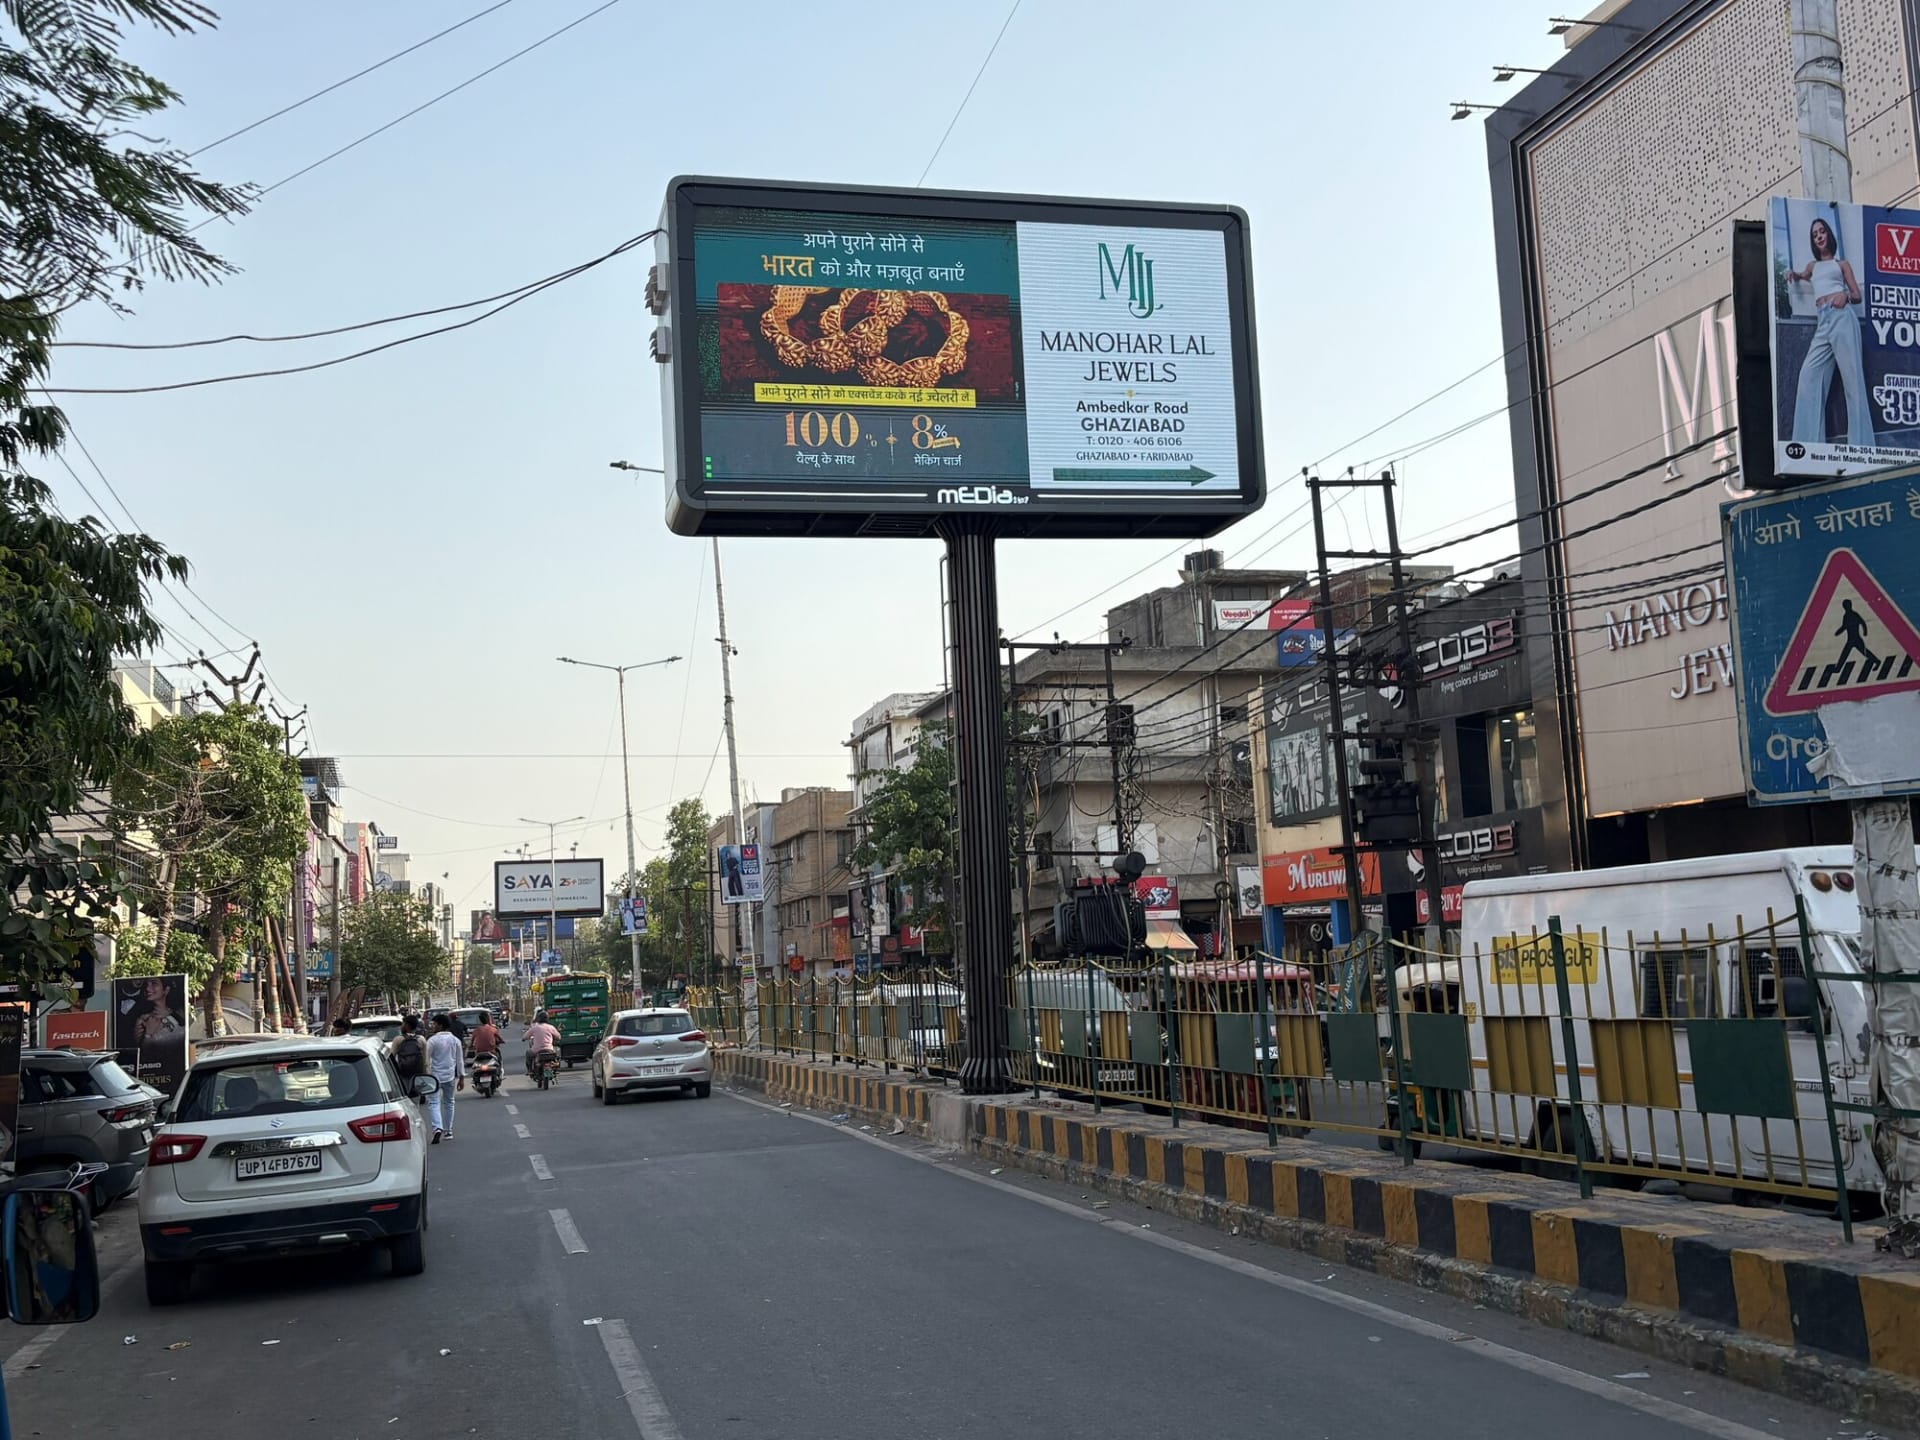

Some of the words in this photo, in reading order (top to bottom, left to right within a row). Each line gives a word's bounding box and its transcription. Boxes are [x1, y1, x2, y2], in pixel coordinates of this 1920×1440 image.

[803, 230, 836, 249] अपने
[840, 232, 875, 255] पुराने
[879, 234, 907, 253] सोने
[911, 235, 925, 254] से
[1888, 228, 1913, 256] V
[761, 254, 815, 278] भारत
[818, 257, 842, 277] को
[846, 258, 872, 278] और
[1871, 308, 1893, 319] FOR
[1896, 309, 1920, 321] EVE
[1040, 331, 1163, 354] MANOHAR
[1170, 334, 1215, 355] LAL
[1083, 361, 1177, 382] JEWELS
[761, 384, 781, 397] अपने
[783, 386, 808, 402] पुराने
[811, 386, 830, 400] सोने
[833, 388, 846, 399] को
[1076, 400, 1149, 414] Ambedkar
[1154, 401, 1188, 414] Road
[1081, 417, 1185, 432] GHAZIABAD
[1086, 436, 1096, 445] T:
[1097, 436, 1124, 445] 0120
[1133, 437, 1154, 446] 406
[1157, 437, 1182, 446] 6106
[1076, 451, 1131, 461] GHAZIABAD
[1140, 452, 1193, 462] FARIDABAD
[1788, 446, 1805, 455] 017
[1811, 453, 1826, 461] Near
[1834, 445, 1847, 454] Plot
[1876, 447, 1903, 457] Mahadev
[821, 452, 832, 465] के
[835, 454, 856, 465] साथ
[1754, 513, 1801, 545] आगे
[1813, 504, 1894, 533] चौराहा
[1222, 609, 1250, 619] Veedol
[1441, 680, 1455, 694] flying
[1455, 675, 1472, 689] colors
[1472, 672, 1479, 684] of
[1479, 667, 1499, 682] fashion
[504, 874, 552, 890] SAYA
[306, 953, 329, 970] 50%
[1521, 947, 1593, 968] PROSGUR
[0, 1014, 17, 1022] TAN
[52, 1030, 100, 1041] fastrack
[138, 1062, 162, 1070] CASIO
[245, 1154, 319, 1175] UP14FB7670
